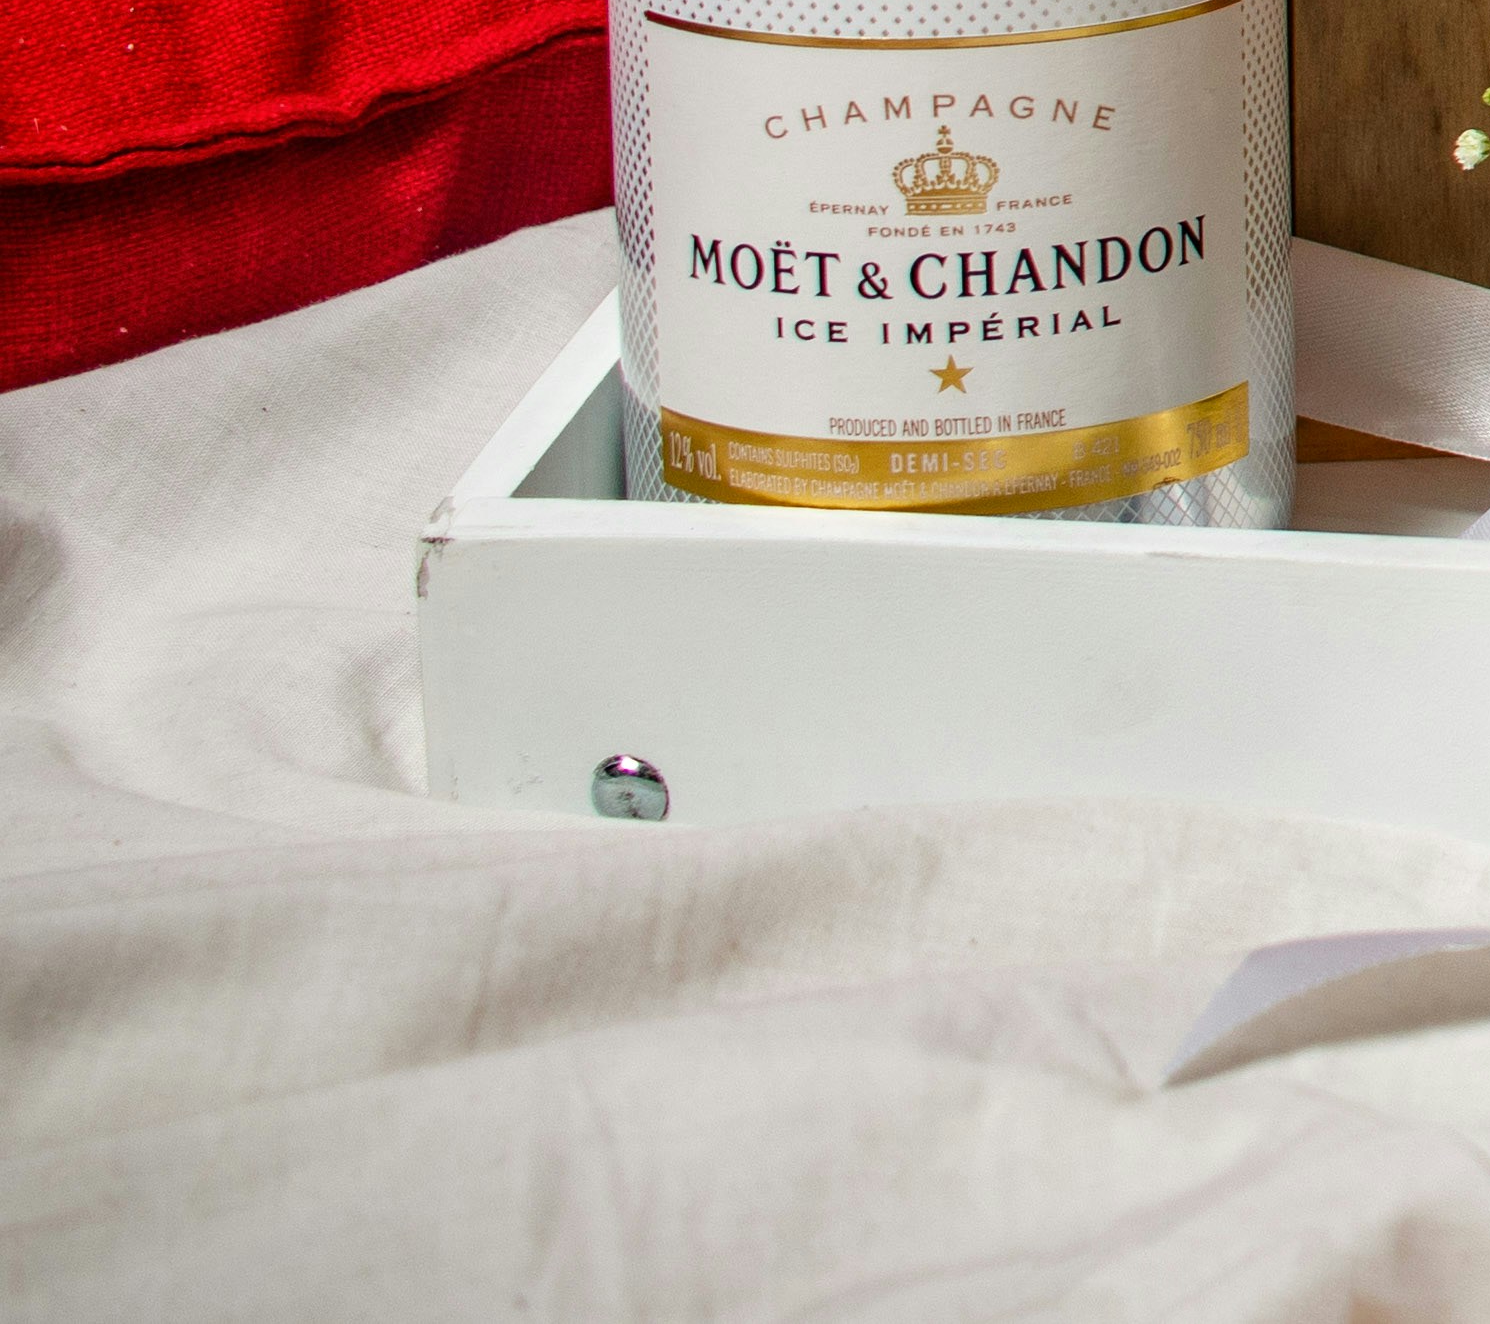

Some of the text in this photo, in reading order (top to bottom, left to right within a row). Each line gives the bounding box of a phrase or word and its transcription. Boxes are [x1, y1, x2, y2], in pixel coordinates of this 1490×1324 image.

[764, 94, 1116, 139] CHAMPAGNE
[809, 193, 1073, 216] ÉPERNAY FRANCE
[868, 222, 1017, 237] FONDÉ EN 1743
[689, 214, 1207, 300] MOËT & CHANDON
[776, 304, 1122, 345] ICE IMPÉRIAL
[829, 408, 1067, 438] PRODUCED AND BOTTLED IN FRANCE
[669, 431, 722, 482] 12% vol.
[728, 440, 774, 463] CONTAINS
[776, 448, 831, 473] SULPHITES
[890, 449, 1007, 474] DEMI-SEC
[811, 479, 879, 500] CHAMPAGNE
